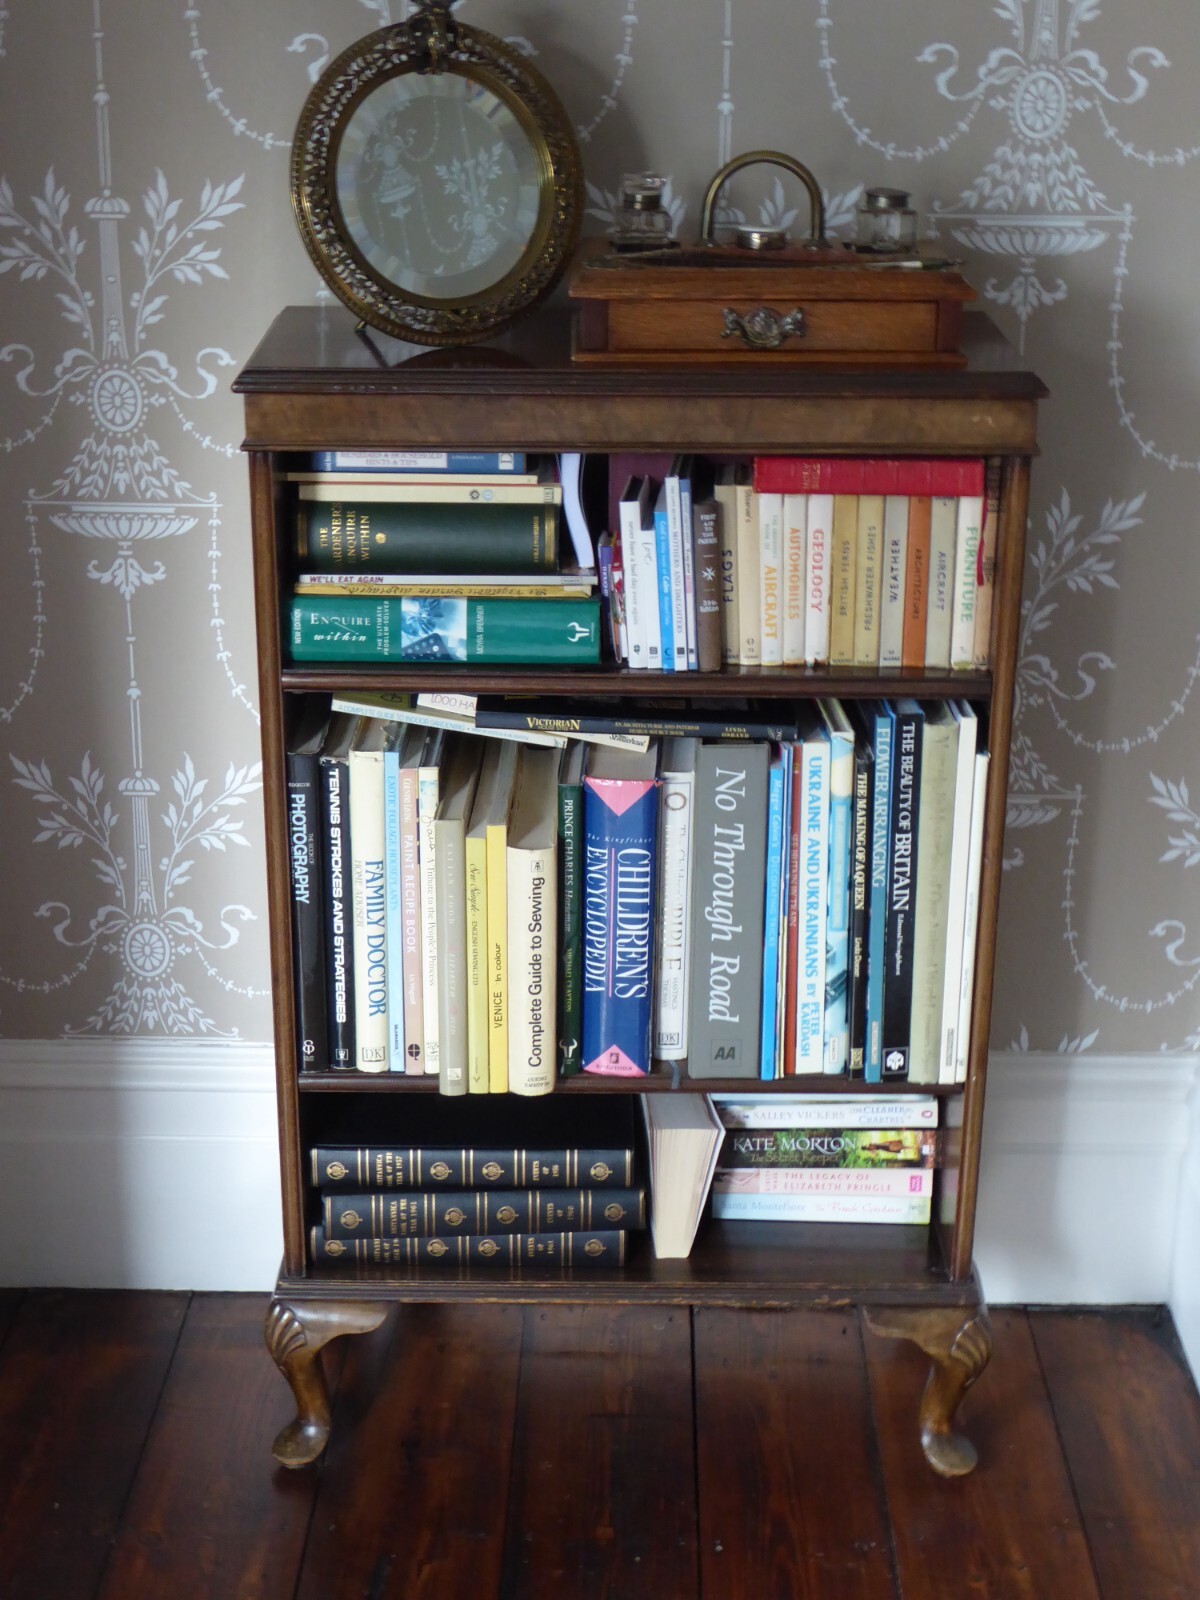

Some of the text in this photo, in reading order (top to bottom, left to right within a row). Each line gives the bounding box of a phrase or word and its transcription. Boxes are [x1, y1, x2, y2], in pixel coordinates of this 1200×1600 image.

[319, 527, 328, 547] THE
[360, 515, 370, 561] WITHIN
[629, 540, 637, 555] have
[309, 575, 385, 584] WE'LL EAT AGAIN
[630, 563, 639, 579] bad
[630, 580, 638, 593] day
[662, 575, 671, 594] Calm
[672, 531, 684, 634] MOTHERS AND DAUGHTERS
[721, 549, 733, 603] FLAGS
[788, 527, 801, 620] AUTOMOBILES
[811, 528, 825, 614] GEOLOGY
[839, 540, 850, 616] BRITISH FERNS
[864, 525, 877, 632] FRESHWATER FISHES
[889, 539, 900, 603] WEATHER
[913, 547, 923, 620] ARCHITECTURE
[936, 551, 947, 611] AIRCRAFT
[960, 526, 979, 623] FURNITURE
[631, 607, 639, 626] again
[764, 565, 778, 640] AIRCRAFT
[293, 608, 302, 645] NEW EDITION
[313, 631, 368, 642] within
[343, 706, 377, 718] COMPLETE
[377, 711, 394, 720] GUIDE
[405, 715, 430, 725] INDOOR
[431, 718, 466, 731] GARDENING
[526, 716, 581, 730] VICTORIAN
[770, 779, 783, 811] Maggie
[872, 727, 891, 888] FLOWER ARRANGING
[564, 799, 574, 837] PRINCE
[892, 722, 916, 912] THE BEAUTY OF BRITAIN
[291, 793, 310, 905] PHOTOGRAPHY
[387, 775, 399, 912] EXOTIC FOLIAGE HOUSEPLANTS
[587, 832, 652, 844] The Kingfisher
[853, 772, 868, 911] THE MAKING OF A QUEEN
[309, 857, 315, 866] OF
[564, 839, 574, 886] CHARLES
[790, 849, 799, 884] BRITAIN
[804, 756, 822, 997] UKRAINE AND UKRAINIANS BY
[328, 768, 347, 1024] TENNIS STROKES AND STRATEGIES
[354, 859, 364, 928] HOME ADVISER
[403, 835, 417, 954] PAINT RECIPE BOOK
[427, 867, 435, 896] Tribute
[704, 766, 747, 1024] No Through Road
[428, 897, 434, 905] to
[585, 844, 609, 992] ENCYCLOPEDIA
[788, 898, 797, 927] TRAIN
[365, 860, 387, 1017] FAMILY DOCTOR
[427, 923, 437, 953] People's
[471, 920, 479, 947] ENGLISH
[615, 847, 652, 999] CHILDREN'S
[471, 948, 479, 973] SEWING
[854, 937, 863, 955] Linda
[428, 955, 437, 986] Princess
[493, 942, 503, 1029] VENICE In colour
[528, 877, 546, 1067] Complete Guide to Sewing
[801, 1003, 811, 1057] KARDASH
[810, 1001, 820, 1036] PETER
[364, 1048, 383, 1060] DK
[661, 1034, 676, 1043] DK
[713, 1046, 736, 1061] AA
[753, 1111, 845, 1121] SALLEY VICKERS
[862, 1105, 905, 1115] CLEANER
[733, 1137, 856, 1155] KATE MORTON
[750, 1152, 840, 1163] The Secret Keeper
[784, 1172, 870, 1181] THE LEGACY OF
[784, 1182, 893, 1192] ELIZABETH PRINGLE
